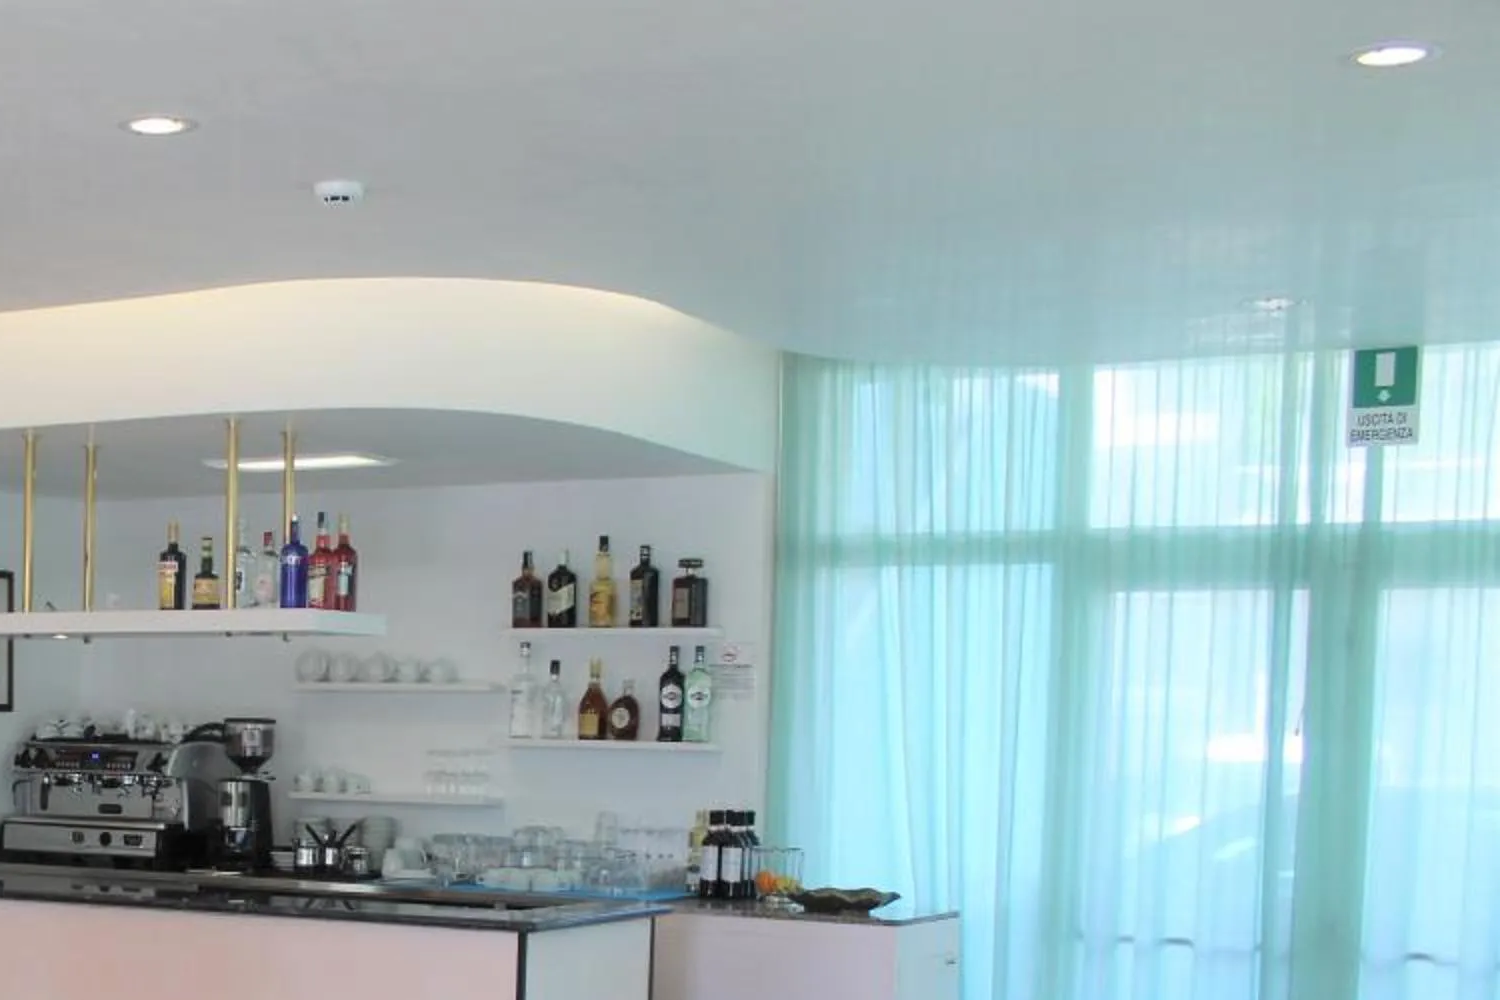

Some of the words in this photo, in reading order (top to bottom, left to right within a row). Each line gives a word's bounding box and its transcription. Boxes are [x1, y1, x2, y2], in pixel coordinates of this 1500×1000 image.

[1357, 412, 1394, 426] USCITA
[1396, 411, 1407, 424] DI
[1350, 427, 1413, 441] EMERGENZA
